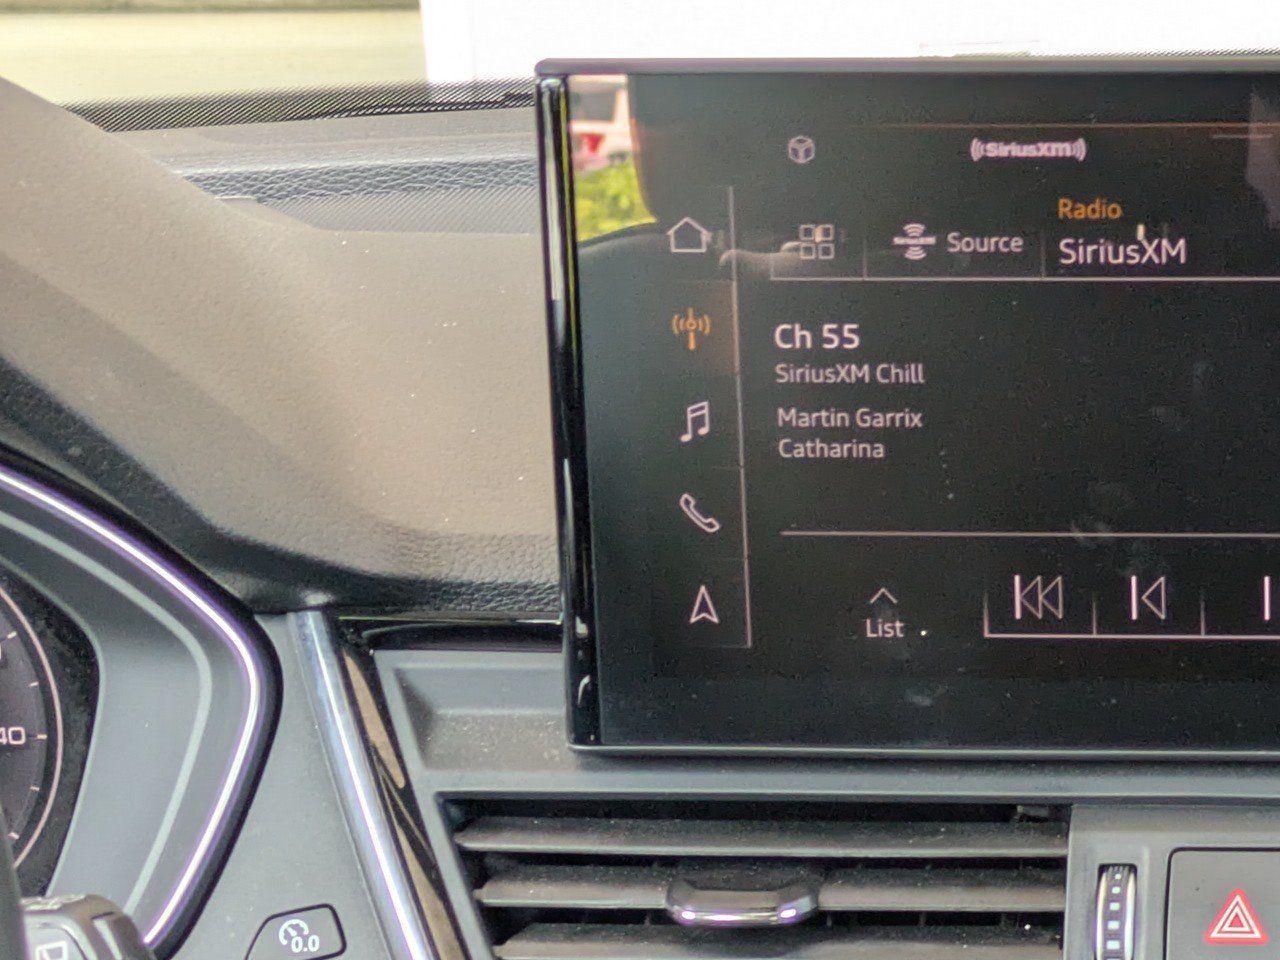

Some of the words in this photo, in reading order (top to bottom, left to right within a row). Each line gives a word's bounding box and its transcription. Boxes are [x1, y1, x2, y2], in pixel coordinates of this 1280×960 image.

[1057, 198, 1123, 220] Radio
[946, 232, 1025, 253] Source
[1058, 235, 1188, 265] SiriusXM
[773, 322, 812, 349] Ch
[821, 323, 861, 349] 55
[774, 362, 870, 384] SiriusXM
[876, 362, 926, 384] Chill
[776, 406, 850, 428] Martin
[854, 407, 924, 428] Garrix
[777, 437, 886, 459] Catharina
[865, 618, 906, 638] List
[291, 934, 320, 953] 0.0
